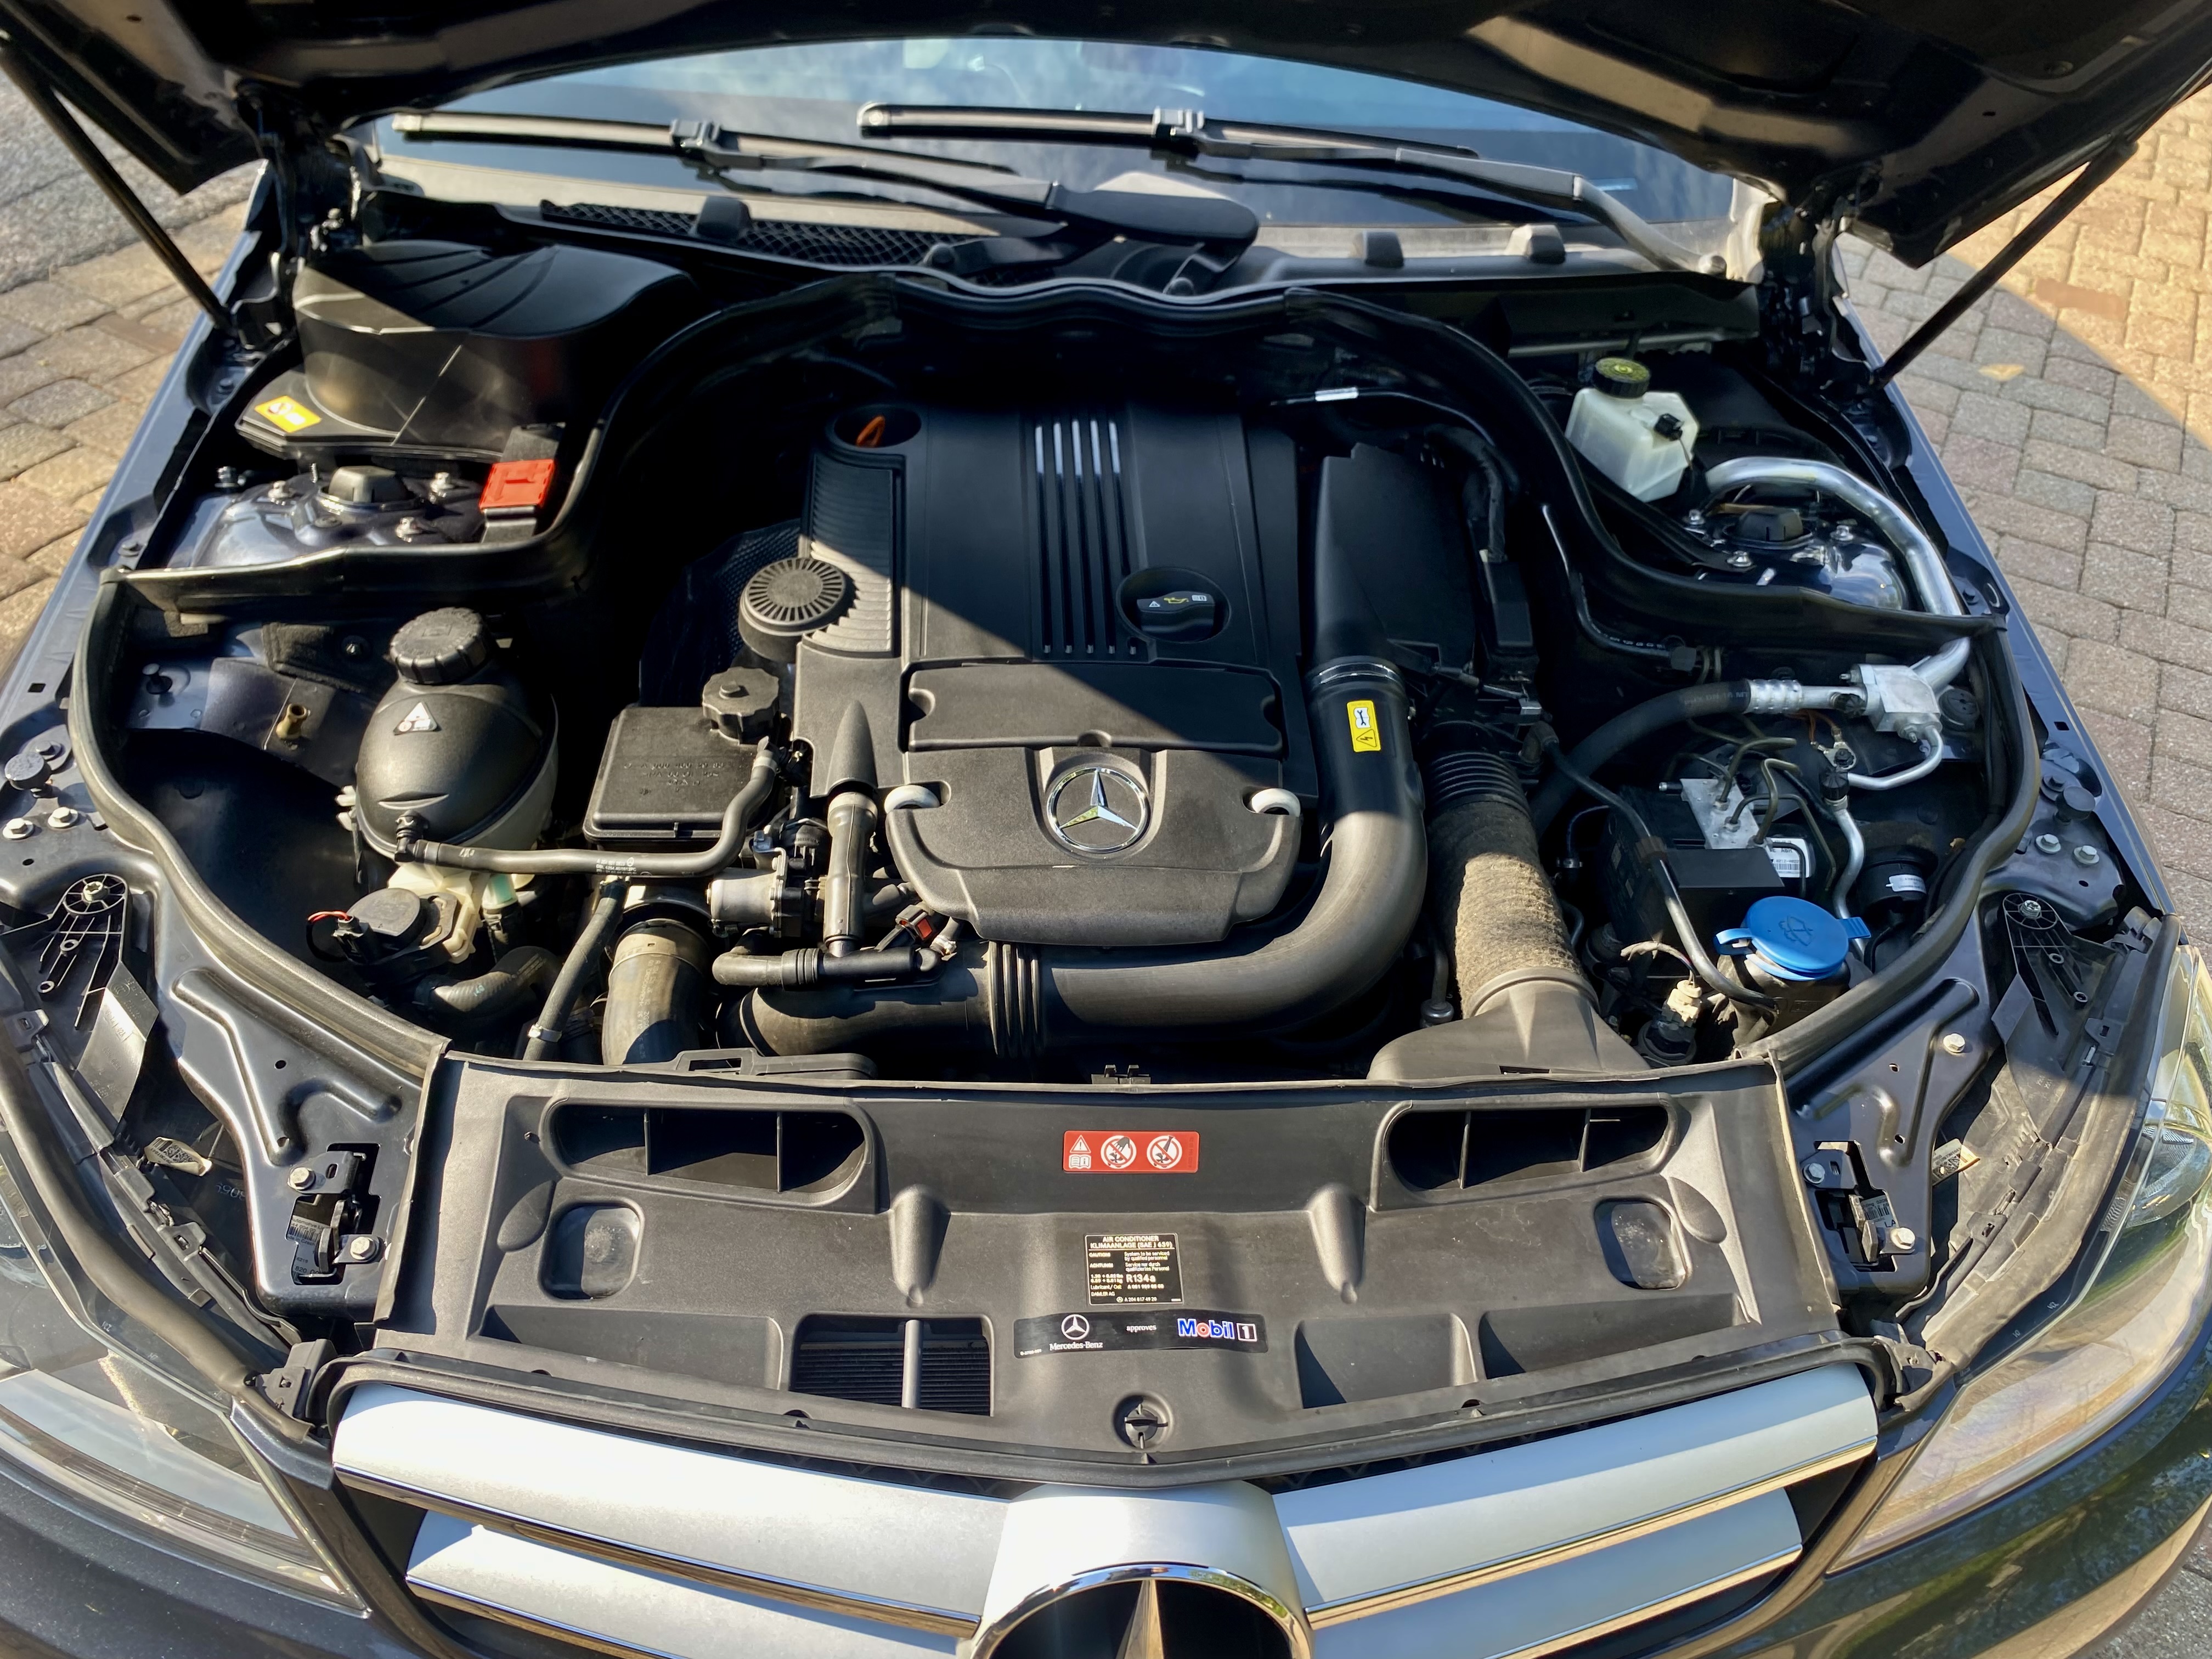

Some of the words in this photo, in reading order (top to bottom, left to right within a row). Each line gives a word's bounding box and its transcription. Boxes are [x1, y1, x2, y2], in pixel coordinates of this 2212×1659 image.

[1126, 1273, 1156, 1283] R134a
[1049, 1341, 1103, 1351] Mercedes-Benz
[1126, 1324, 1157, 1333] approves
[1177, 1318, 1235, 1339] Mobil
